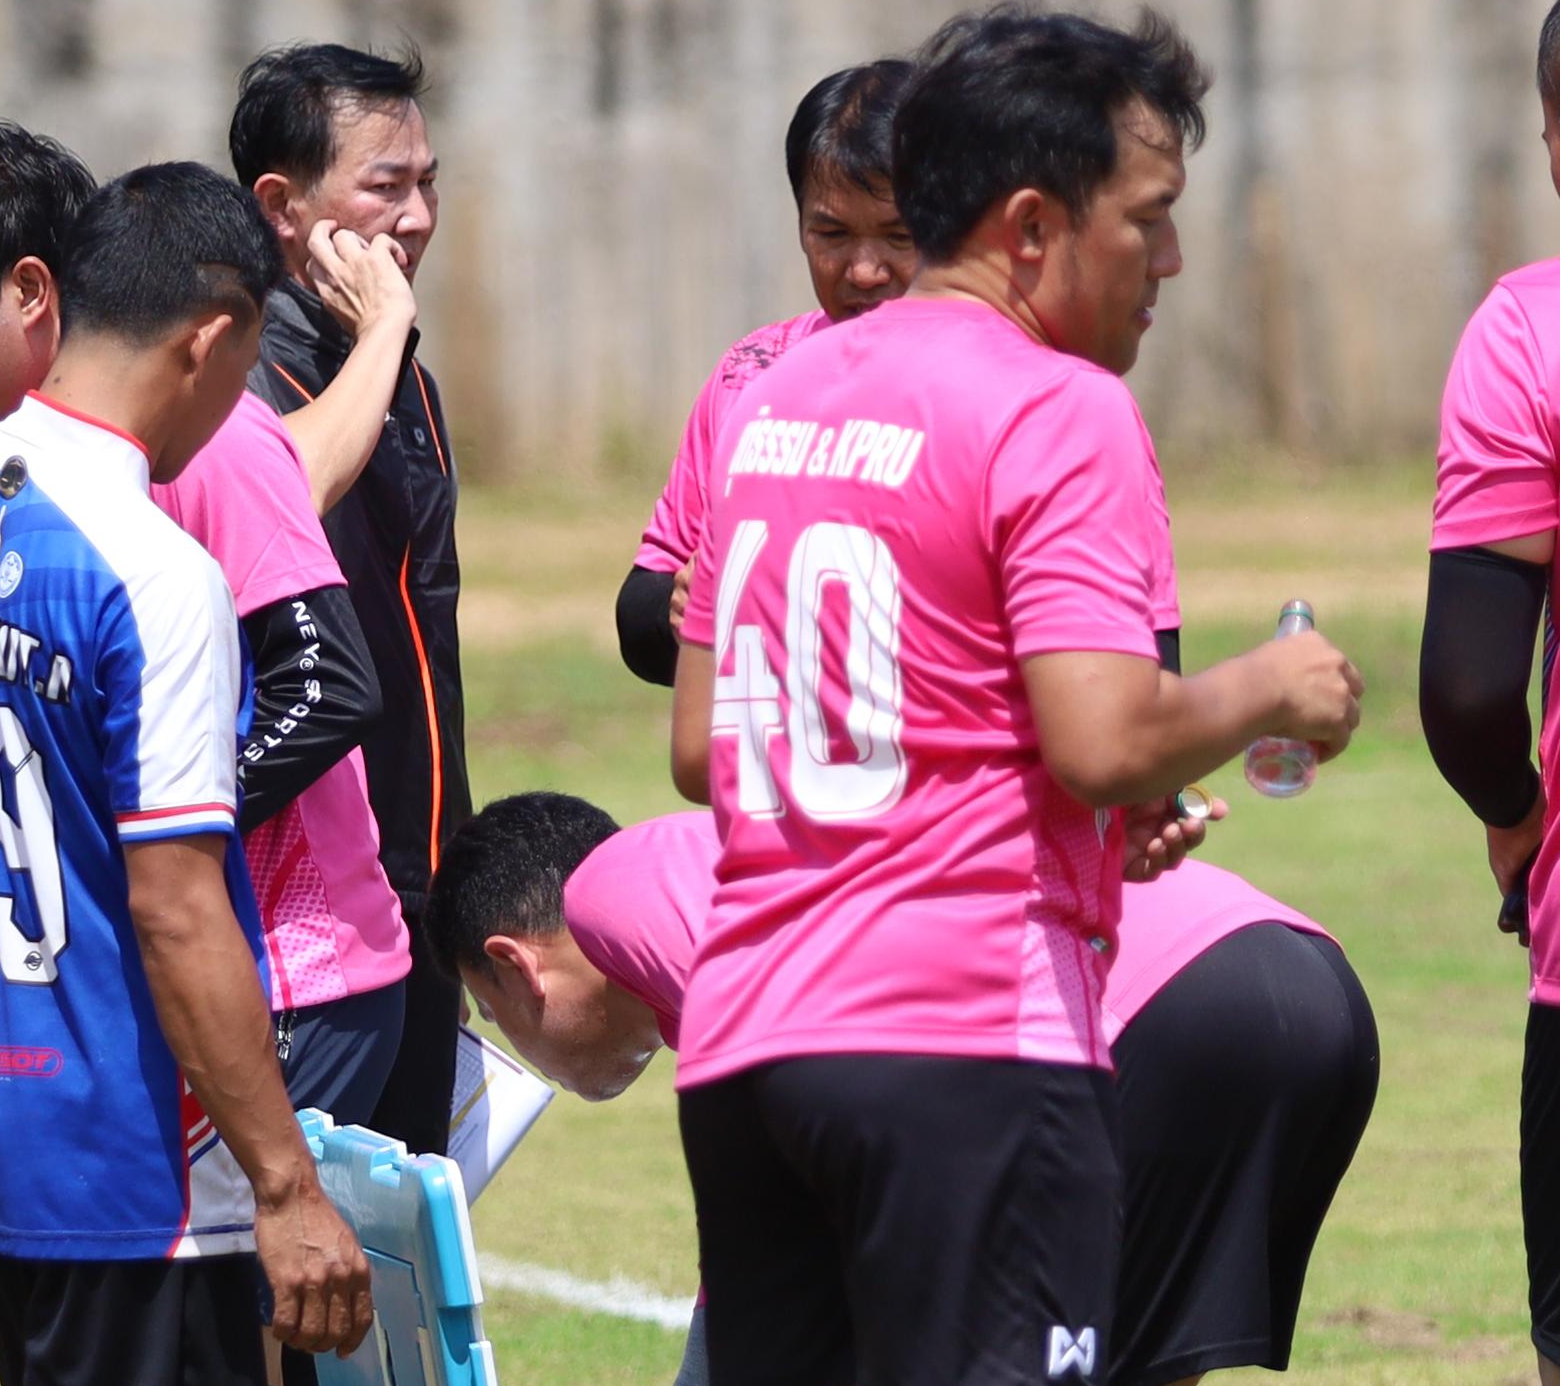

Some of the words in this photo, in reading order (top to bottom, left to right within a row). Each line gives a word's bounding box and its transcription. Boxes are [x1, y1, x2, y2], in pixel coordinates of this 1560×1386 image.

[805, 426, 835, 477] &
[826, 419, 925, 488] KPRU
[711, 519, 908, 821] 40
